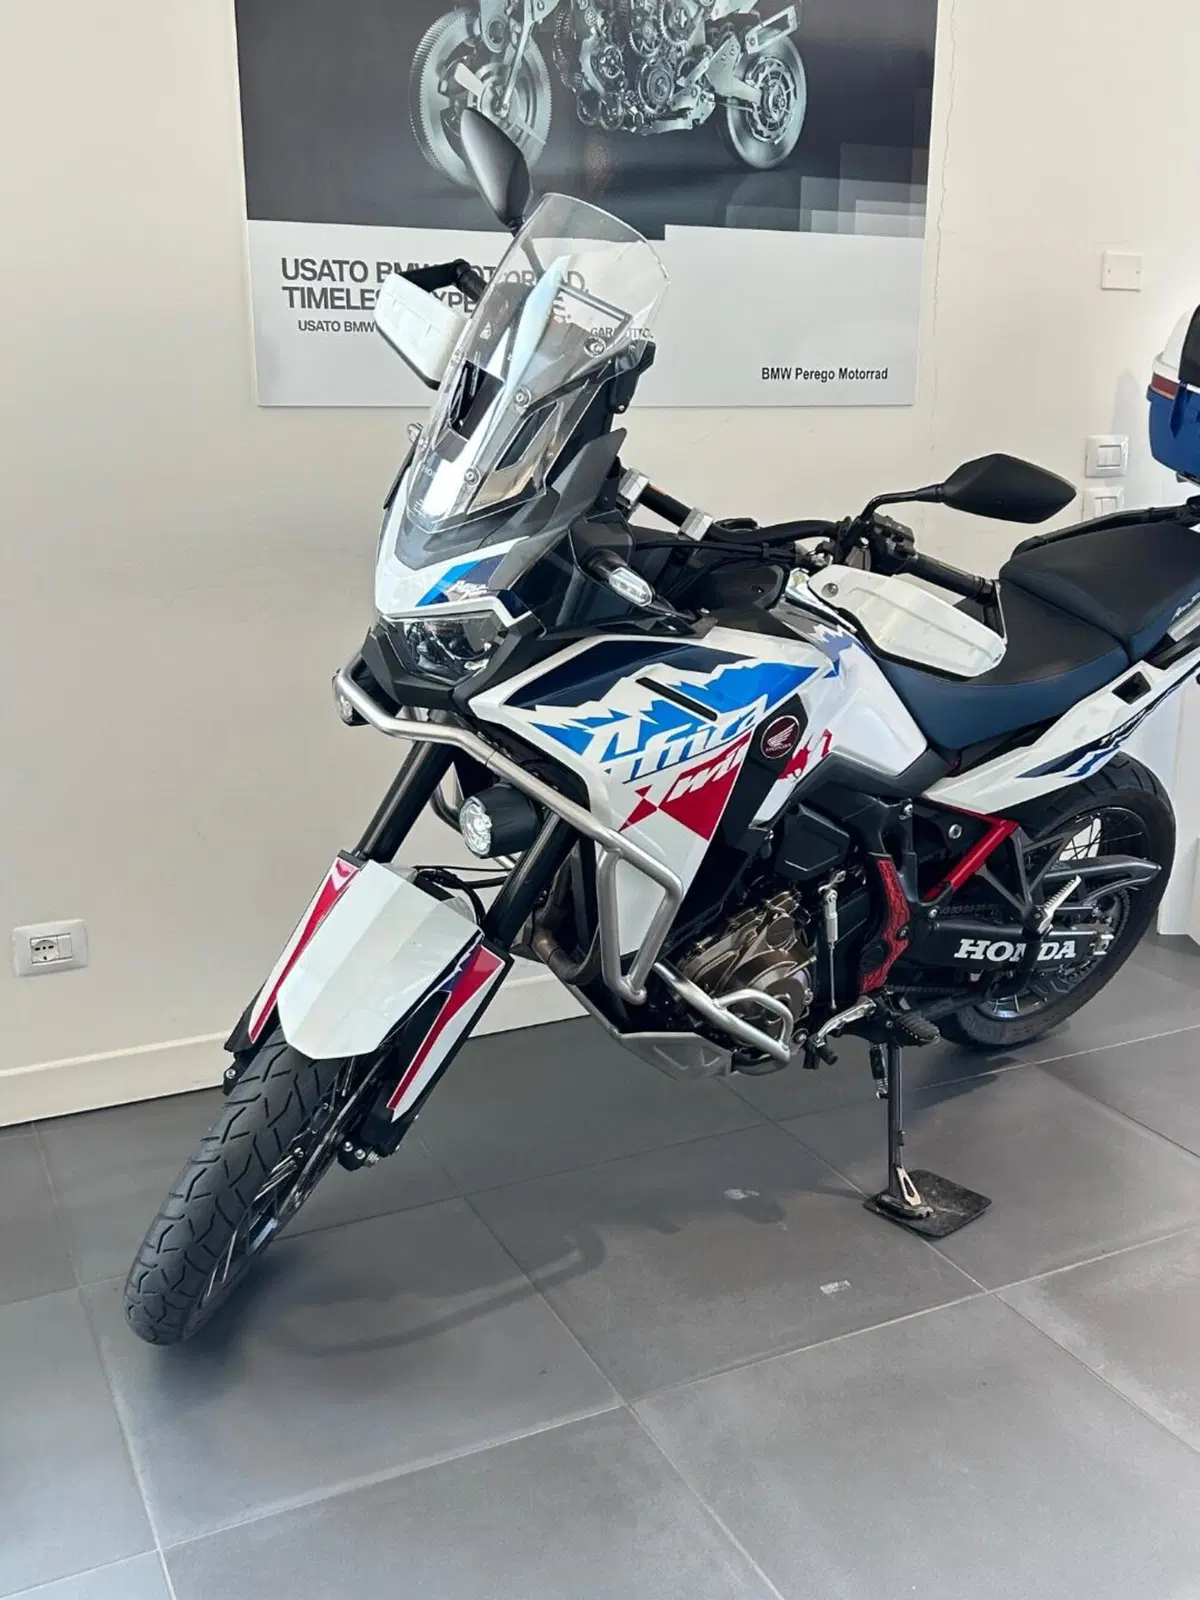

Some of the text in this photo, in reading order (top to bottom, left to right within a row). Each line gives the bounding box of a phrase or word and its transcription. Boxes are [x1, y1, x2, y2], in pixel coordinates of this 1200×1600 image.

[281, 257, 369, 283] USATO
[281, 286, 381, 310] TIMELE
[298, 320, 341, 332] USATO
[344, 321, 375, 332] BMW
[761, 367, 888, 383] BMW Perego Motorrad
